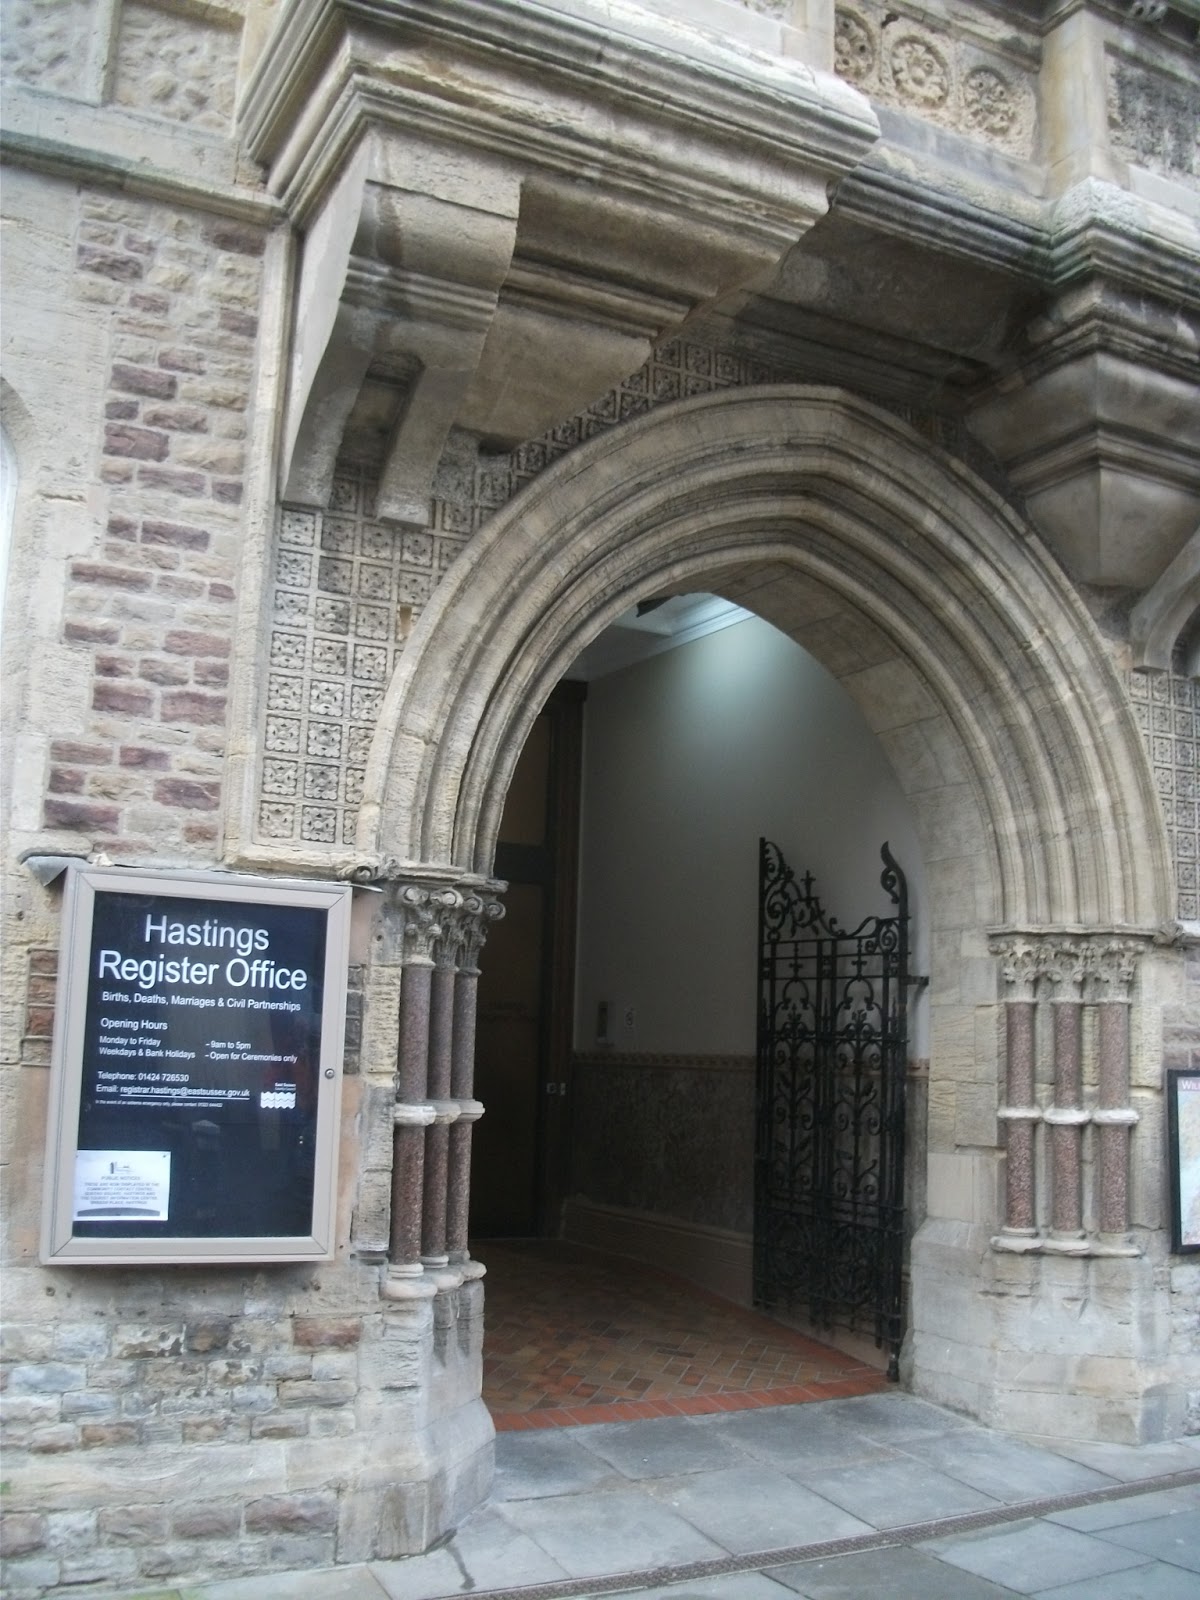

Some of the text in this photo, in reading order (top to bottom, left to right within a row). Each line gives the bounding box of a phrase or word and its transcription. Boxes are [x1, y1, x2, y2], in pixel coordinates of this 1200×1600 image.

[144, 913, 270, 957] Hastings
[98, 949, 308, 991] Register Office
[102, 991, 301, 1013] Births, Deaths, Marriages & Civil Partnerships
[100, 1017, 168, 1031] Opening Hours
[99, 1035, 161, 1048] Monday to Friday
[227, 1041, 235, 1049] to
[235, 1041, 252, 1050] 5pm
[99, 1046, 196, 1059] Weekdays & Bank Holidays
[230, 1051, 241, 1060] for
[241, 1052, 282, 1062] Ceremonies
[283, 1053, 298, 1064] only
[97, 1070, 137, 1081] Telephone:
[138, 1072, 160, 1081] 01424
[95, 1083, 250, 1097] Email: registrar.hastings@eastsussex.gov.uk
